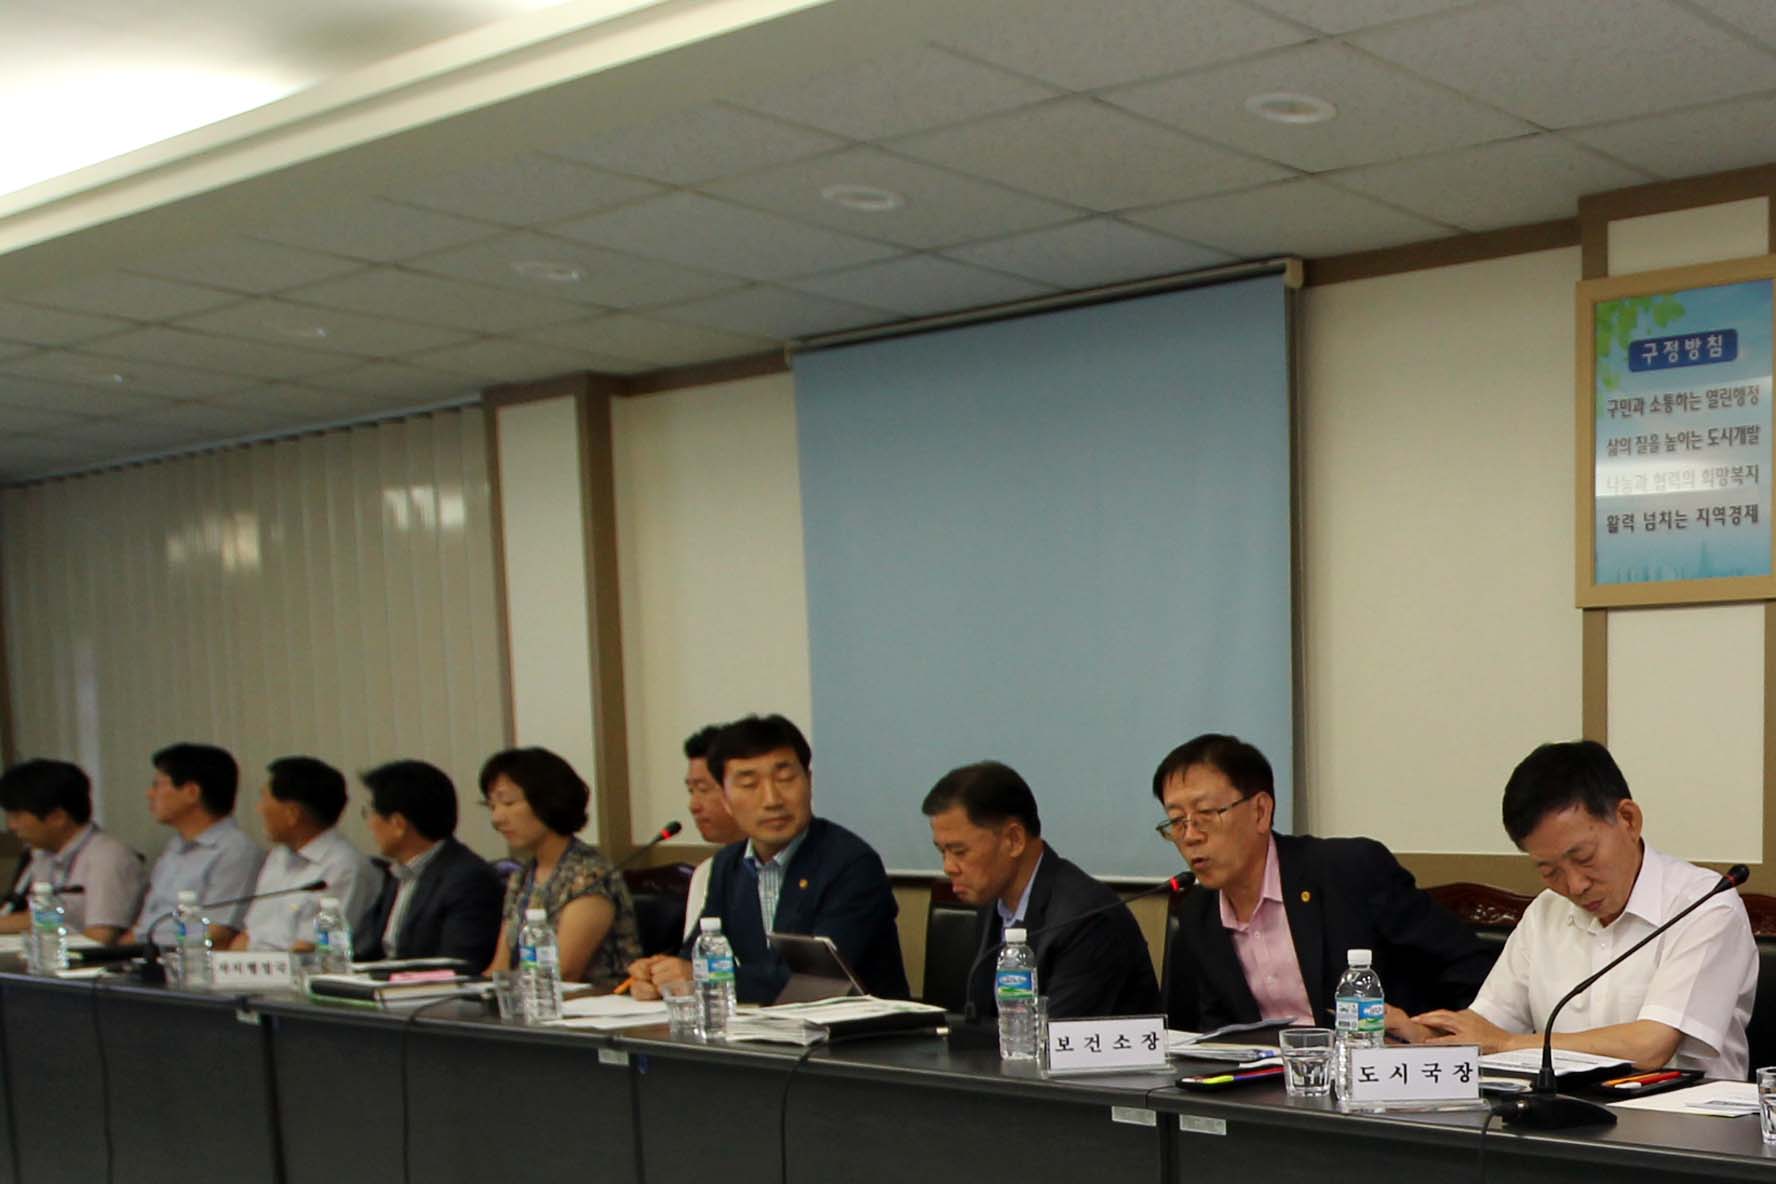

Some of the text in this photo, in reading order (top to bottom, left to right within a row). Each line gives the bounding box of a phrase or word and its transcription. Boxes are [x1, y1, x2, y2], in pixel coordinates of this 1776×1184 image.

[1641, 333, 1724, 365] 구정방침
[1606, 385, 1760, 419] 구민과 소통하는 열린행정
[1607, 424, 1760, 457] 삶의 질을 높이는 도시개발
[1702, 463, 1760, 488] 희망복지
[1606, 503, 1760, 534] 활력 넘치는 지역경제
[1055, 1031, 1161, 1054] 보건소장
[1358, 1061, 1474, 1085] 도시국장
